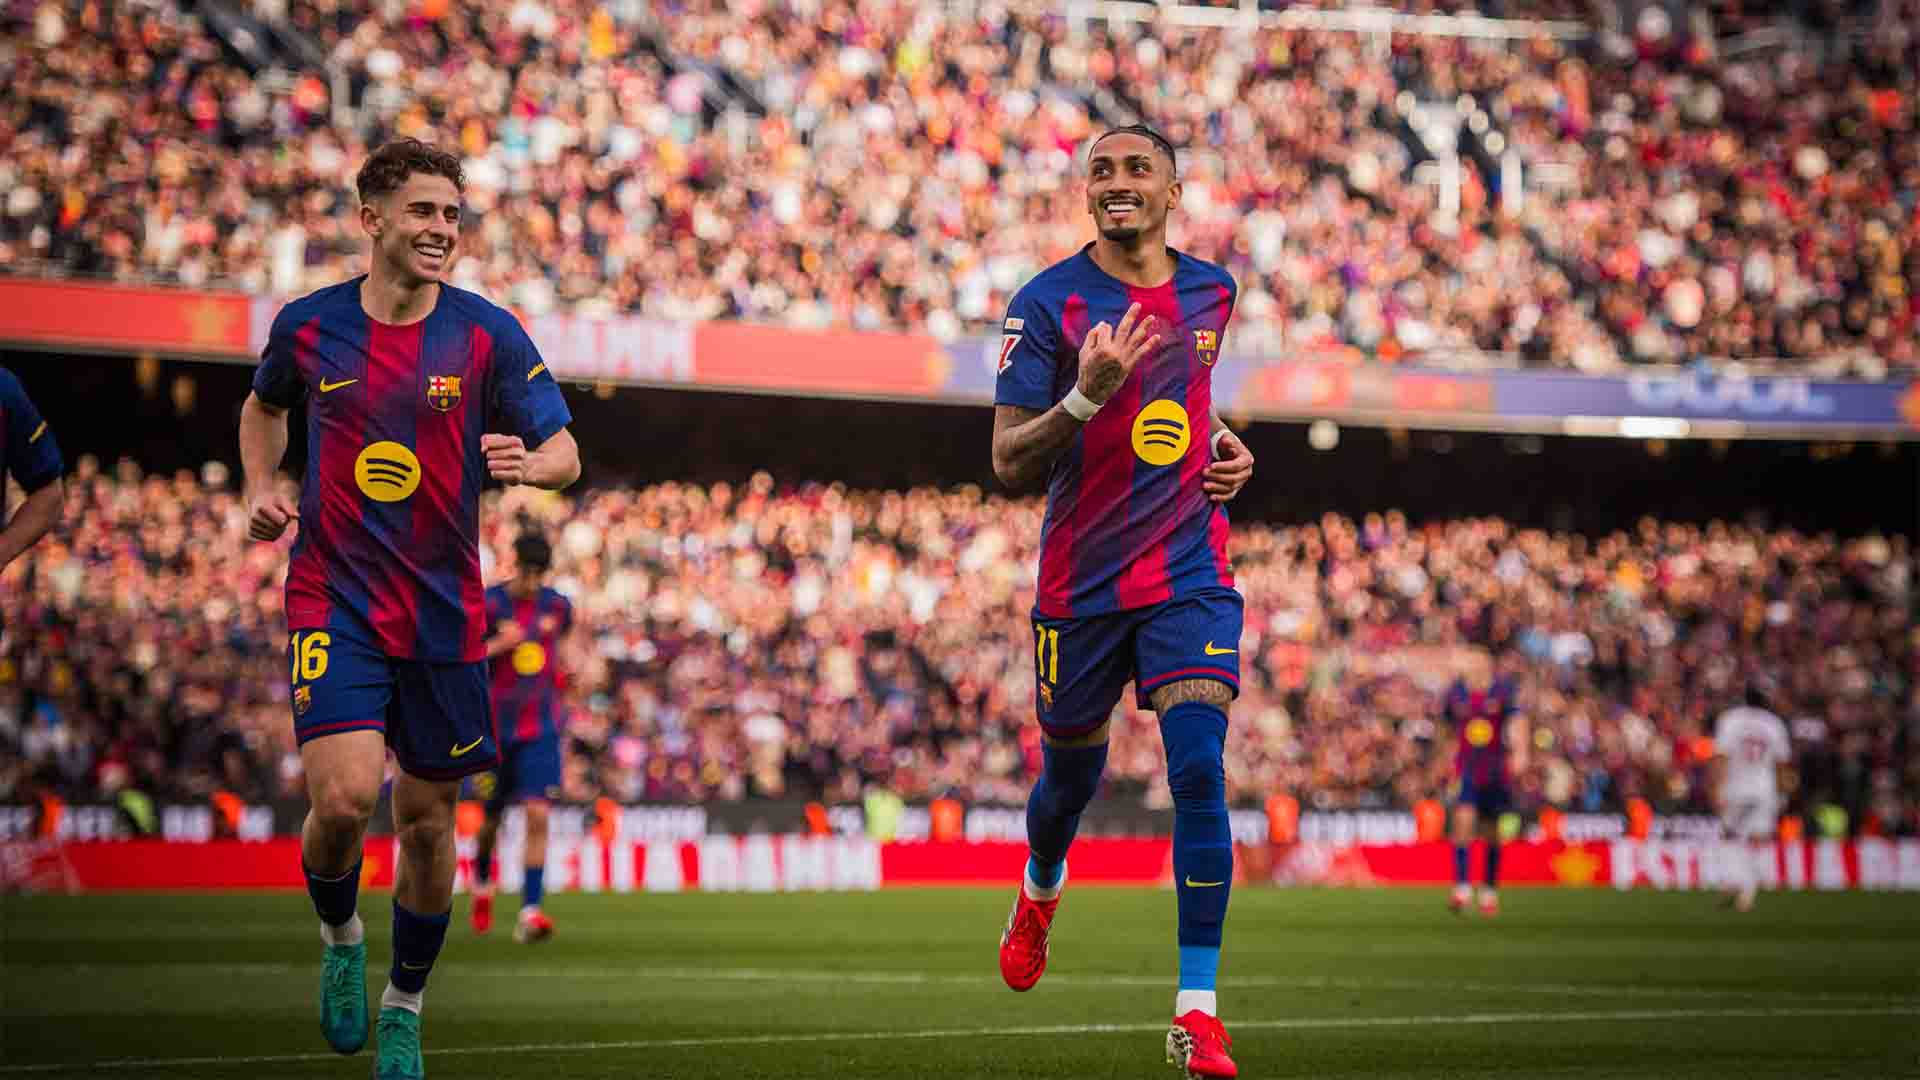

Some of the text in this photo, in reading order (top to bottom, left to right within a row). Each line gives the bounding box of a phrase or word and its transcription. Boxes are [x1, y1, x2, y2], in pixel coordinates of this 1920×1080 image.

[291, 631, 331, 685] 16
[1036, 623, 1058, 685] 11
[699, 834, 877, 891] DAMM
